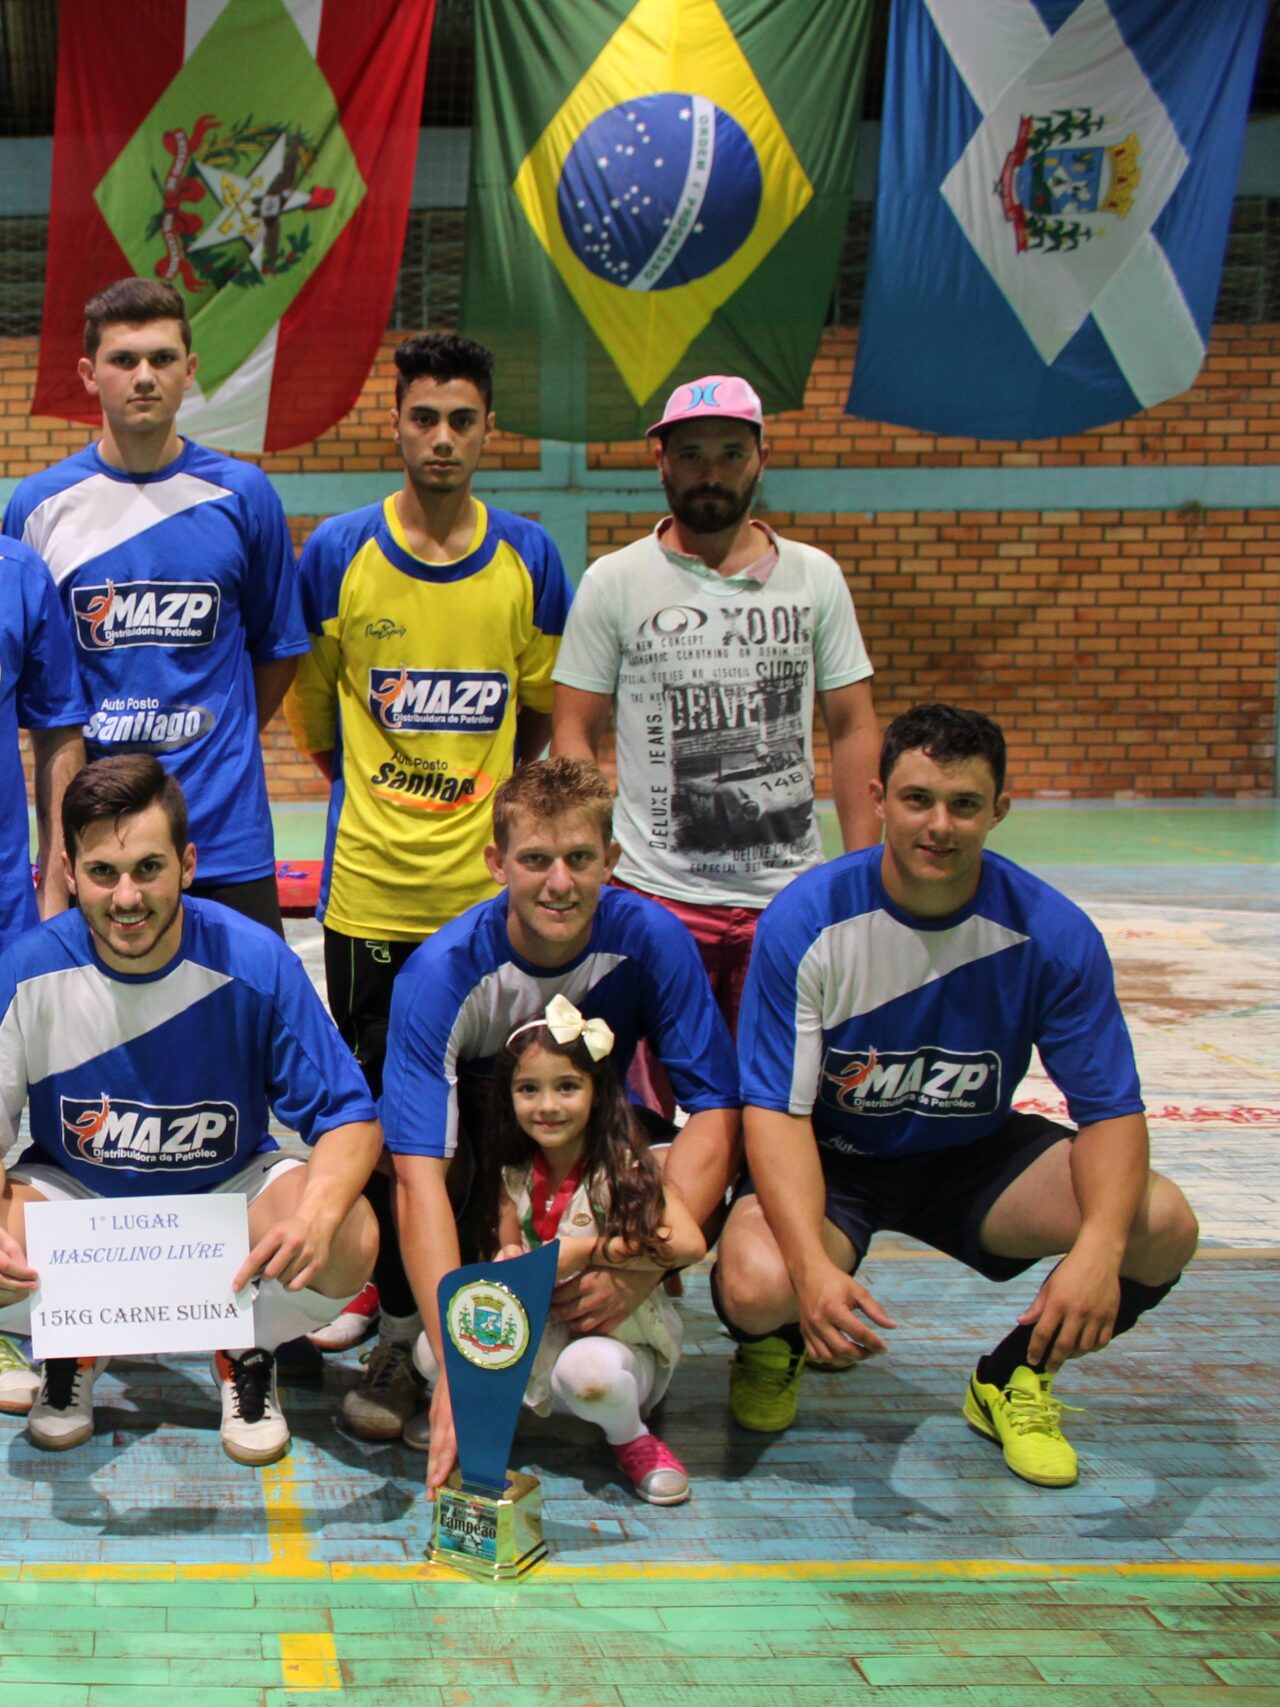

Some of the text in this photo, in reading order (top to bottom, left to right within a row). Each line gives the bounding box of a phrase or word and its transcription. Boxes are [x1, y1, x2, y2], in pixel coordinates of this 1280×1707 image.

[103, 592, 213, 631] MAZP
[164, 627, 202, 637] Petróleo
[101, 697, 159, 711] Auto Posto
[392, 679, 502, 715] MAZP
[82, 711, 200, 743] Santiago
[393, 712, 445, 723] Distribuidora
[447, 714, 458, 723] de
[415, 757, 449, 772] Posto
[648, 785, 669, 850] DELUXE
[853, 1057, 988, 1099] MAZP
[931, 1098, 976, 1108] Petróleo
[92, 1112, 227, 1154] MAZP
[93, 1148, 218, 1162] Distribuidora de Petróleo
[112, 1213, 180, 1231] LUGAR
[49, 1241, 226, 1265] MASCULINO LIVRE
[39, 1300, 239, 1328] 15KG CARNE SUÍNA
